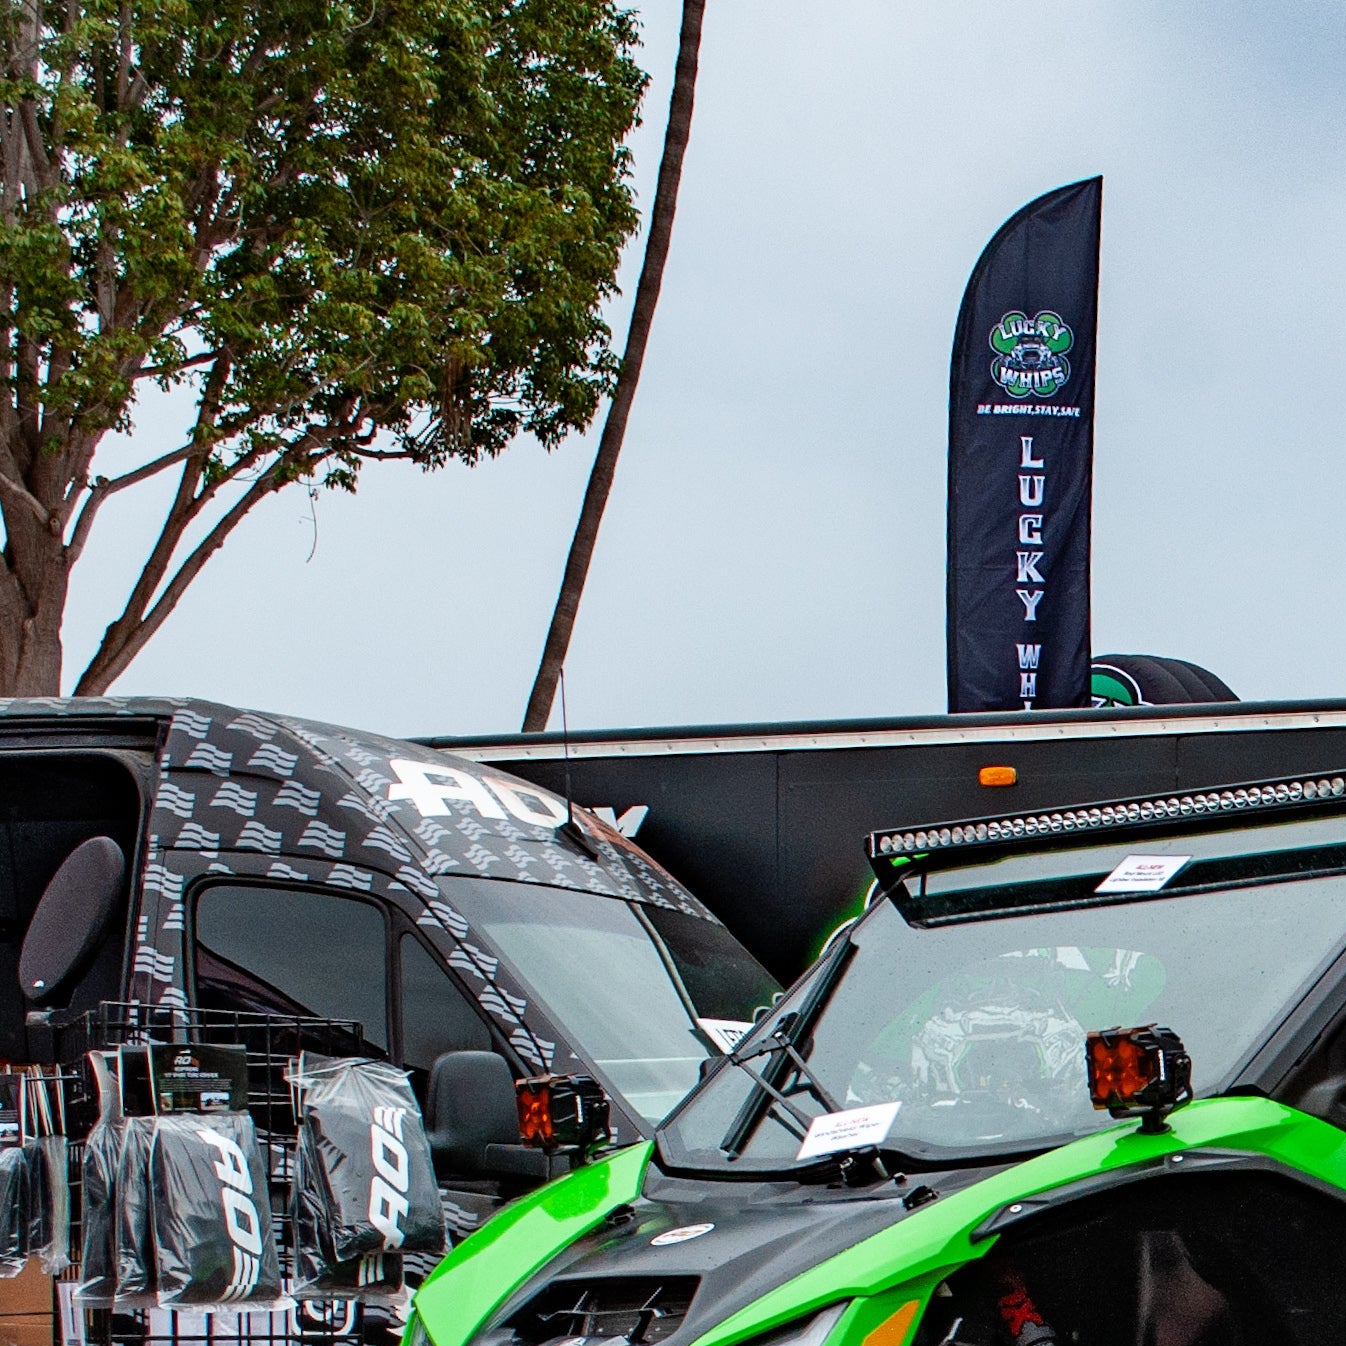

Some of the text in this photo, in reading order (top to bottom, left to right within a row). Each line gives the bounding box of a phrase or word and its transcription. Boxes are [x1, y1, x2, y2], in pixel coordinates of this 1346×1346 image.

[999, 320, 1067, 341] LUCKY
[1000, 366, 1066, 389] WHIPS
[1016, 436, 1046, 621] LUCKY
